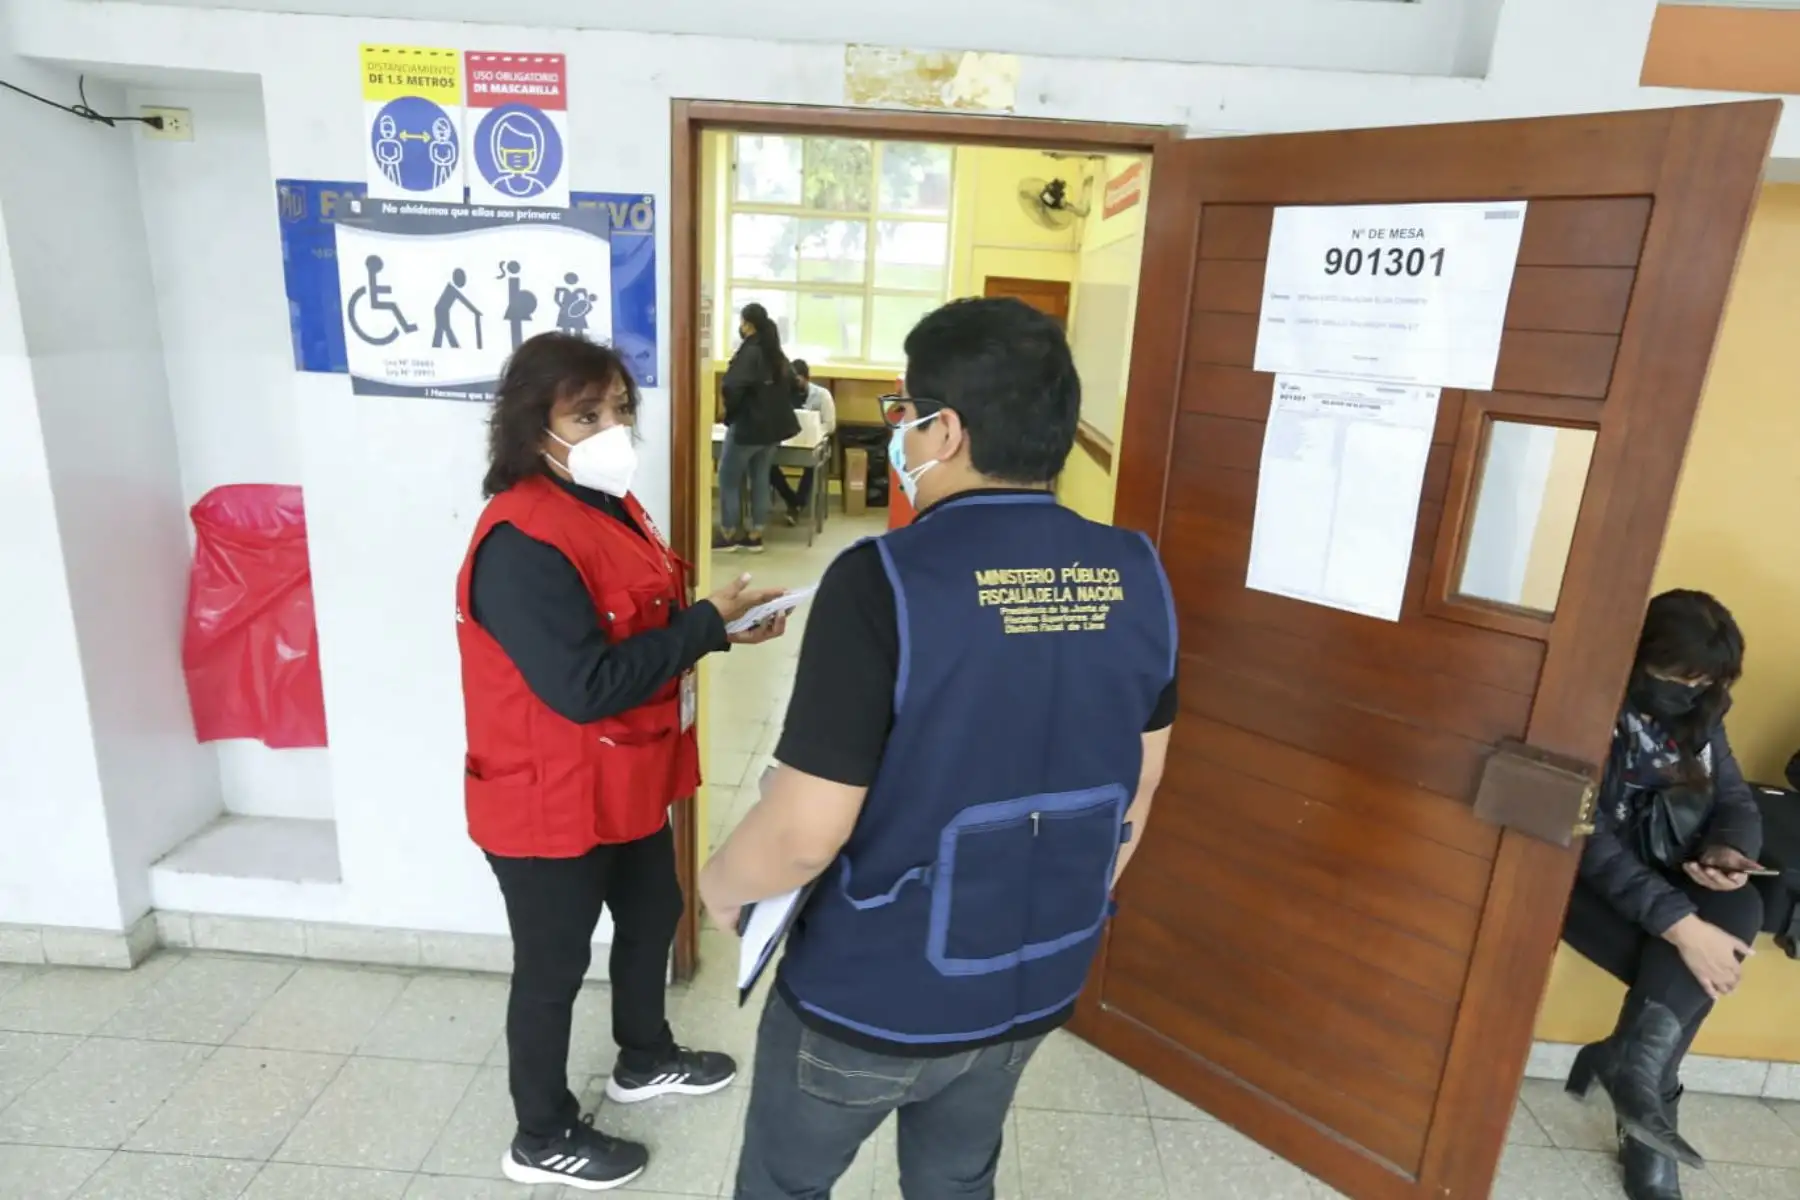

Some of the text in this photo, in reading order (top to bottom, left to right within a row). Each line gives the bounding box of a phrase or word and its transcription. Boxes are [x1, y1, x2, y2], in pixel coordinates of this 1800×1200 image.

[367, 61, 456, 75] DISTANCIAMIENTO
[369, 73, 455, 88] DE 1.5 METROS
[473, 70, 559, 83] USO OBLIGATORIO
[473, 82, 559, 95] DE MASCARILLA
[382, 202, 399, 213] No
[451, 207, 469, 219] que
[1368, 229, 1385, 239] DE
[1389, 228, 1425, 239] MESA
[1323, 247, 1446, 276] 901301
[975, 562, 1120, 586] MINISTERIO PÚBLICO
